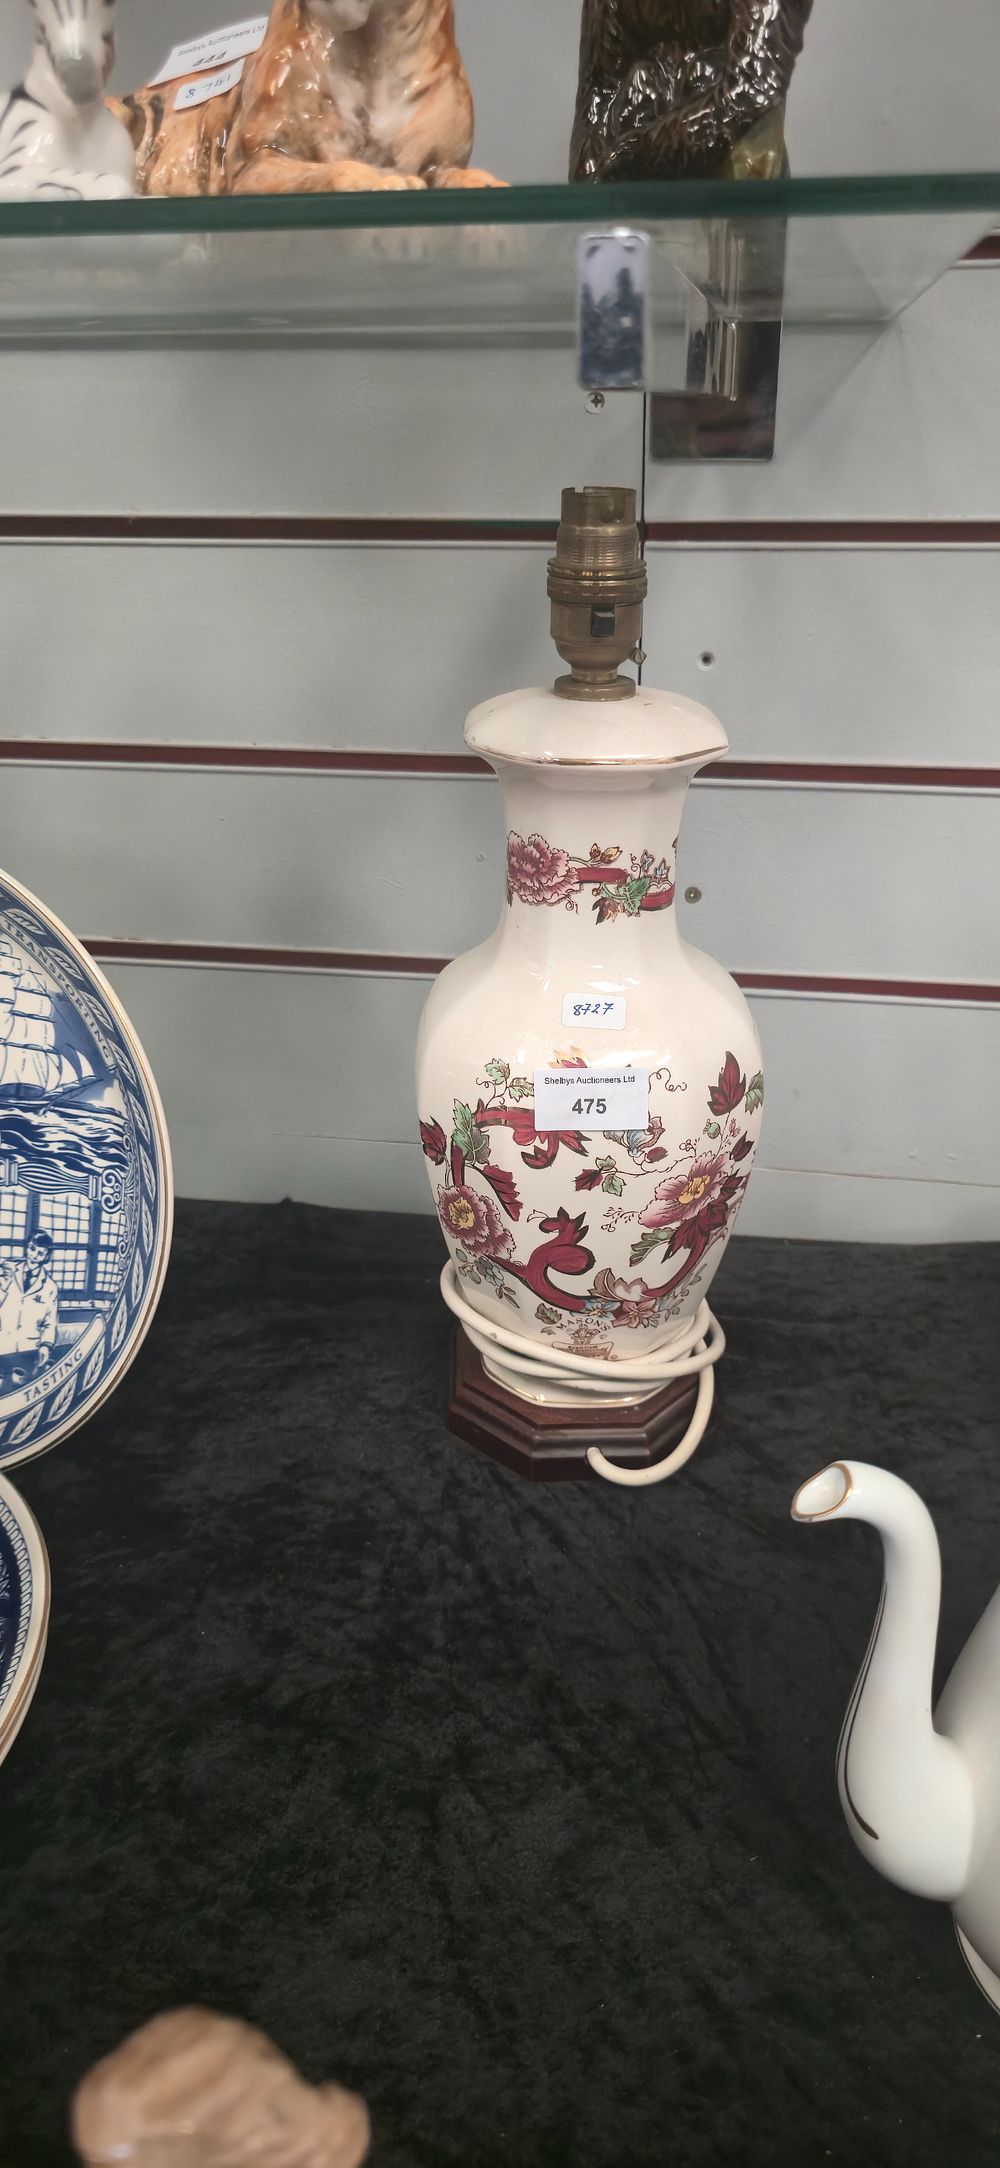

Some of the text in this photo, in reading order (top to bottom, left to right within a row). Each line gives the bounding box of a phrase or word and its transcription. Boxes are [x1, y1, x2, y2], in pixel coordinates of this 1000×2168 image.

[4, 919, 110, 1059] TRANSPORTING
[573, 1003, 614, 1016] 8727
[544, 1075, 636, 1086] Shelbys Auctioneers Ltd
[571, 1098, 607, 1115] 475
[23, 1348, 82, 1402] TASTING
